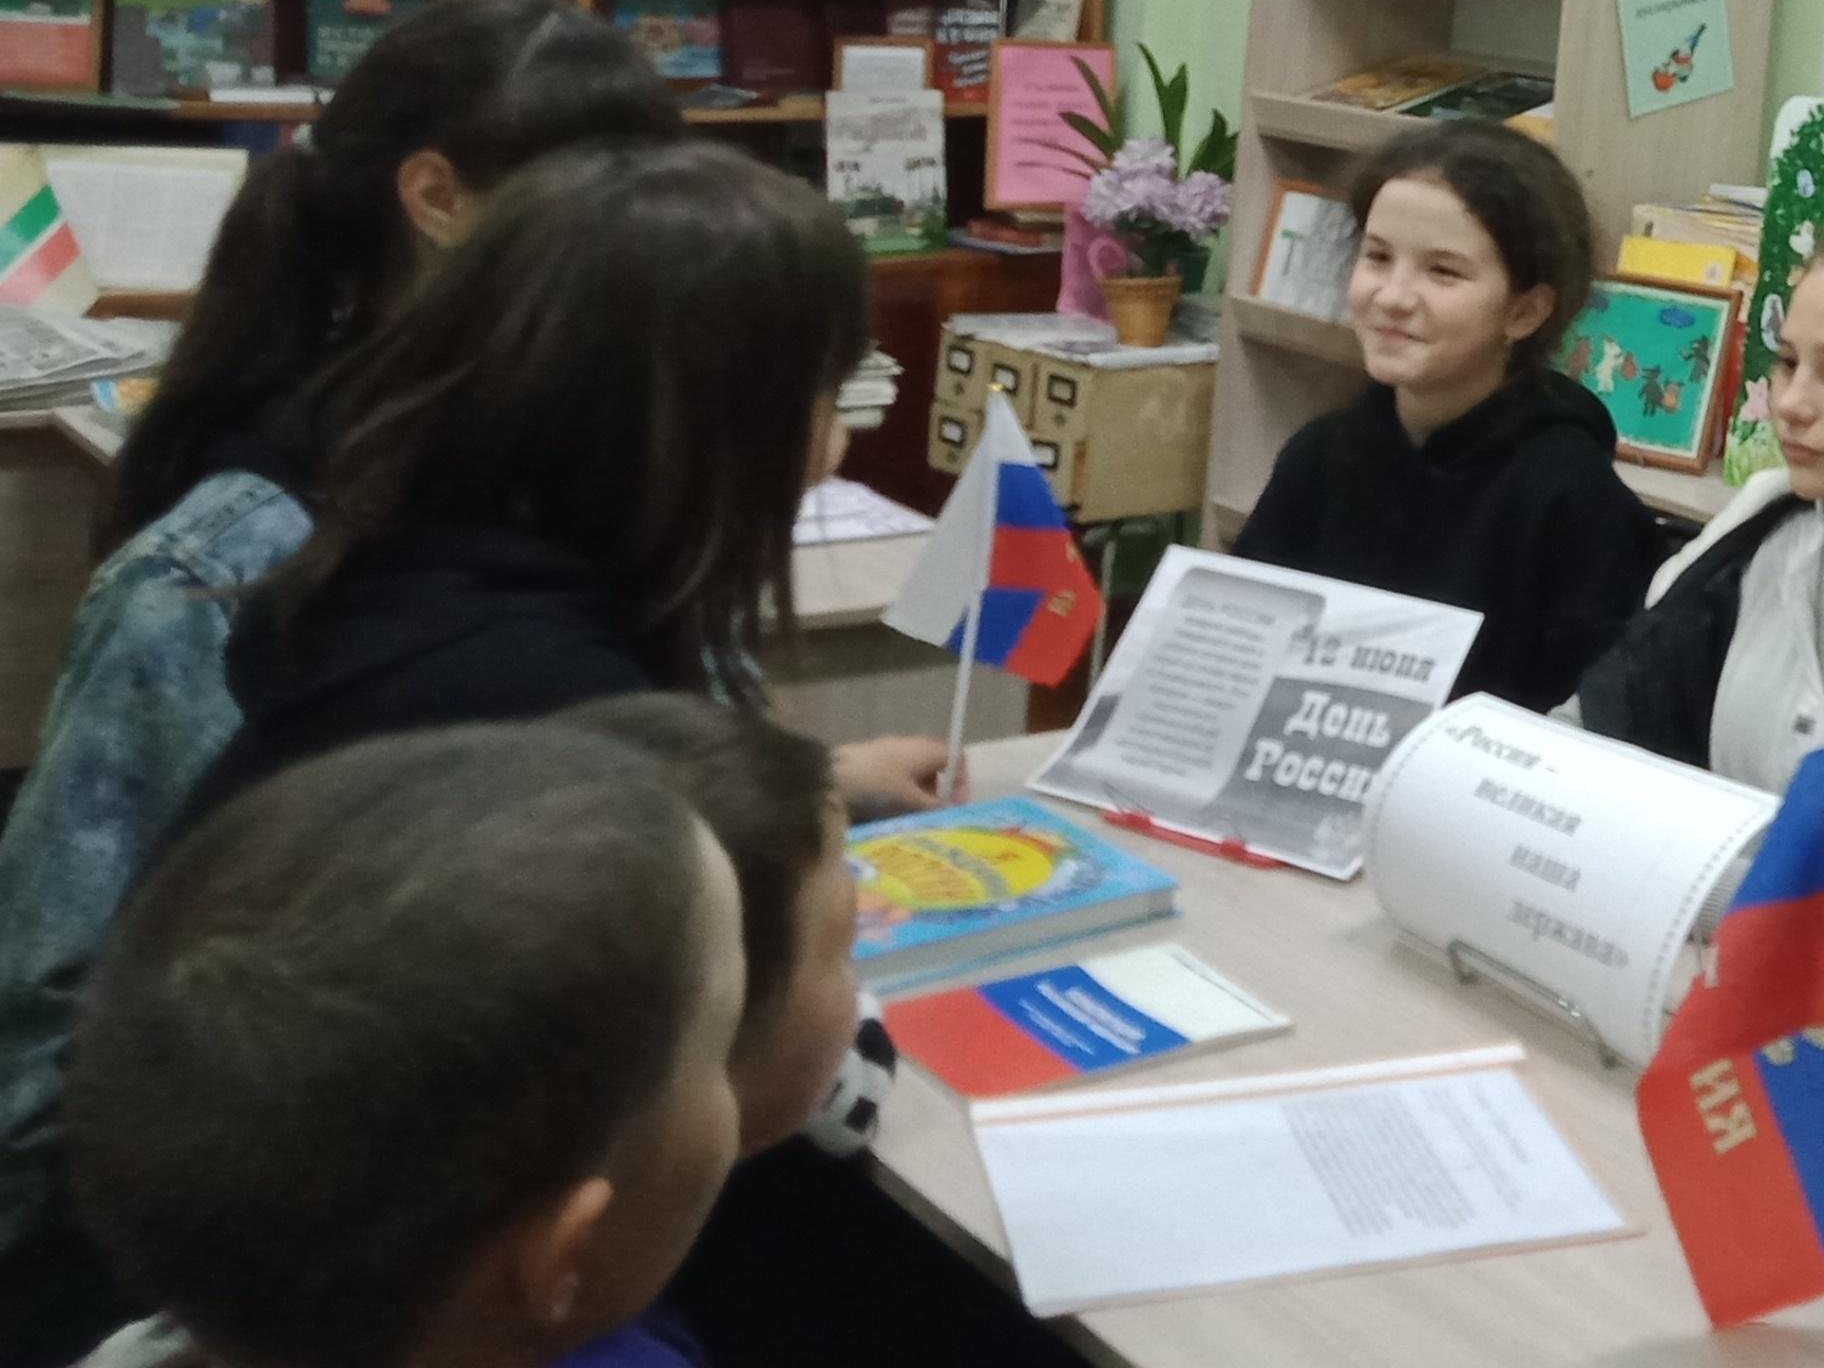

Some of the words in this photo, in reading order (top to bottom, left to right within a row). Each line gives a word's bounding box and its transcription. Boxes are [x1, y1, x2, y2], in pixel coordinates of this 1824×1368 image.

[1351, 644, 1435, 683] июня
[1282, 689, 1392, 749] День
[1244, 736, 1374, 806] Росси
[1474, 777, 1582, 837] великая
[1509, 843, 1582, 892] наша
